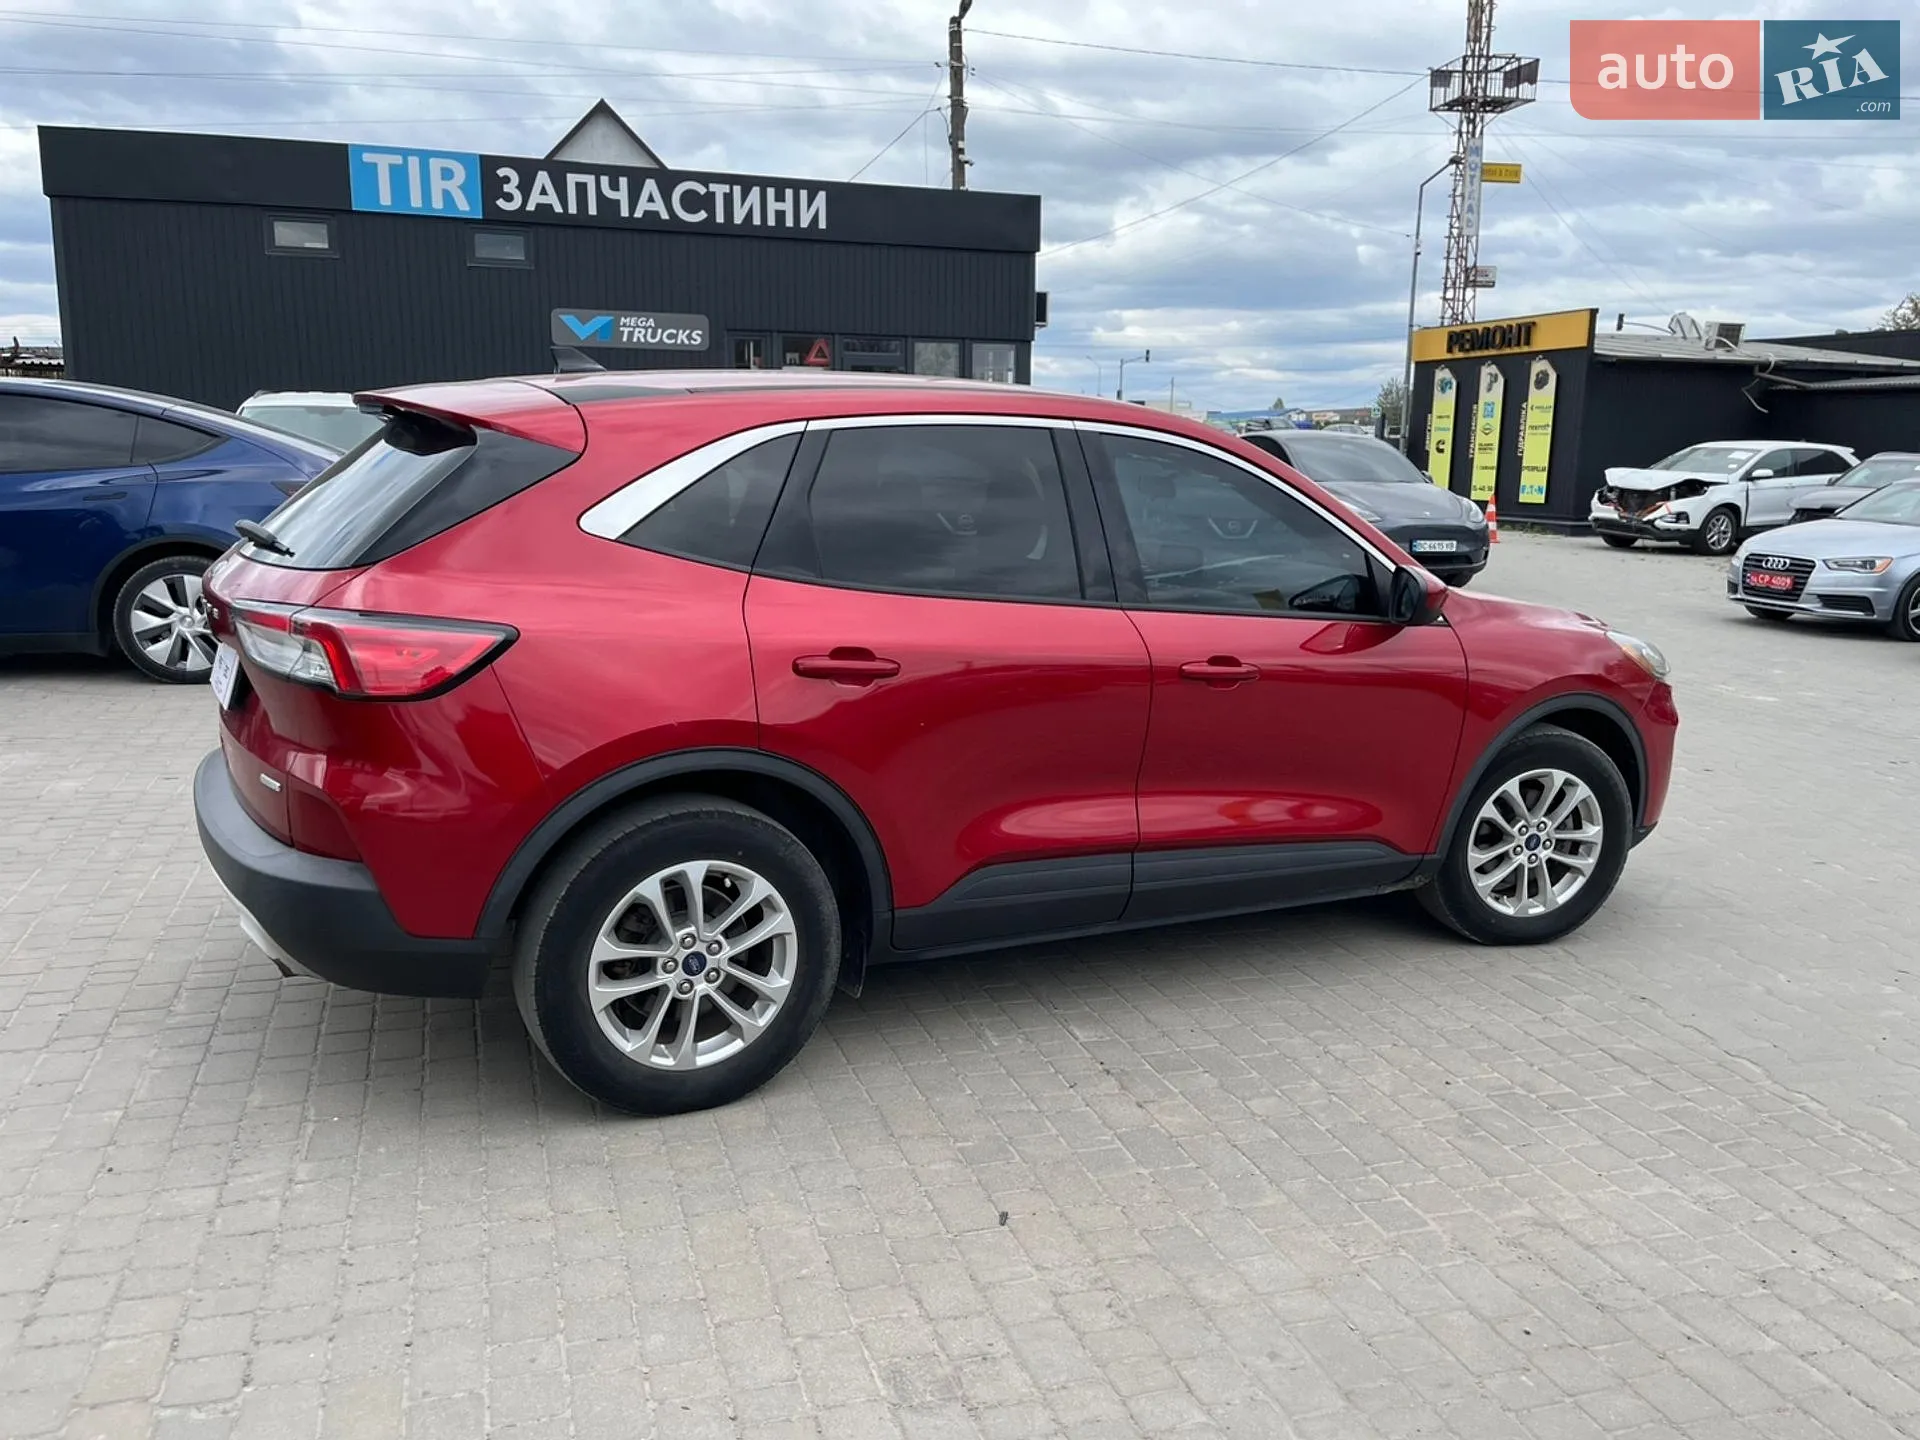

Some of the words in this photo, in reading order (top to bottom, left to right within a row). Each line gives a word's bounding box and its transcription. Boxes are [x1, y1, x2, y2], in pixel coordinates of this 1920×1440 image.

[362, 152, 471, 212] TIR
[495, 166, 827, 229] ЗАПЧАСТИНИ
[619, 316, 656, 327] MEGA
[619, 327, 703, 345] TRUCKS
[1447, 322, 1536, 353] РЕМОНТ
